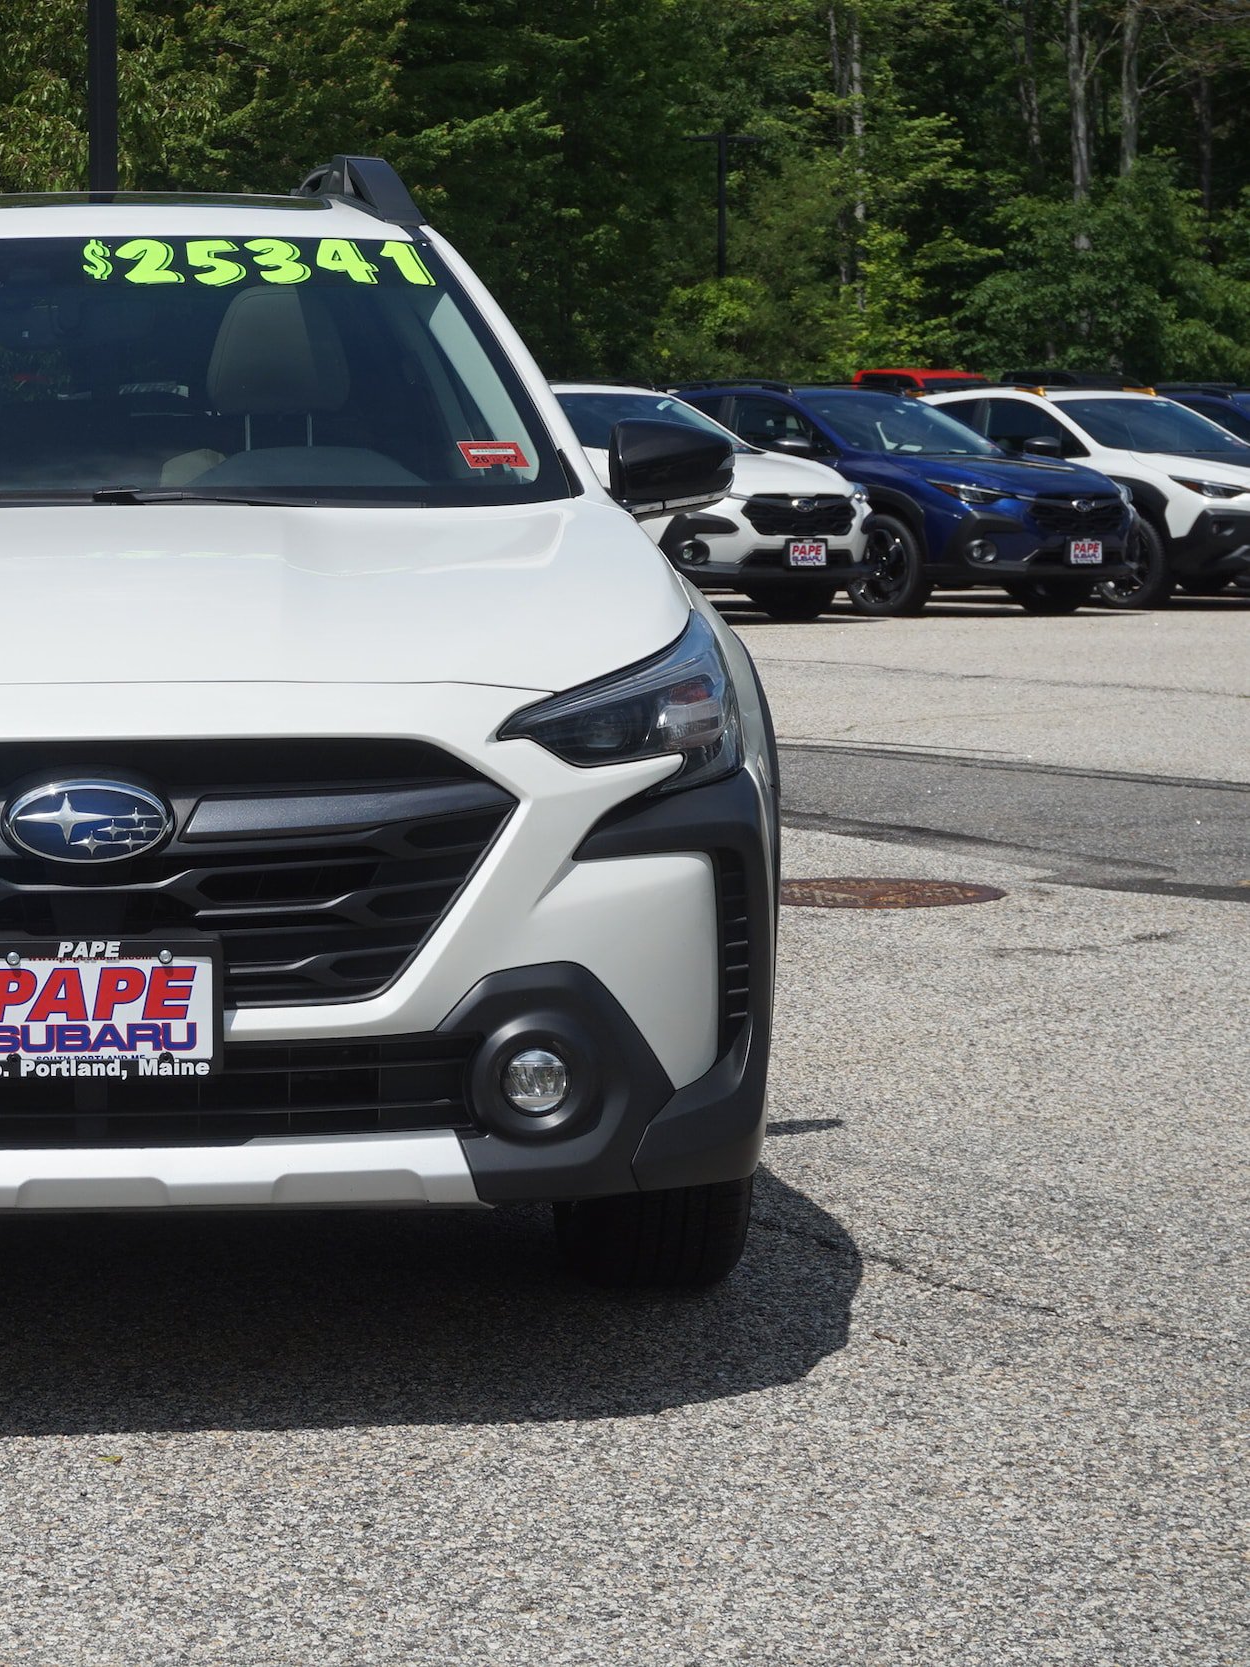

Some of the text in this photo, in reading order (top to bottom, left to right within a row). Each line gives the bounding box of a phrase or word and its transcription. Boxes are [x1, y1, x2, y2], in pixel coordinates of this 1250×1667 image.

[82, 238, 437, 287] $25341
[792, 545, 823, 555] PAPE
[1074, 543, 1100, 553] PAPE
[57, 941, 121, 958] PAPE
[20, 1059, 128, 1080] Portland,
[138, 1058, 210, 1077] Maine
